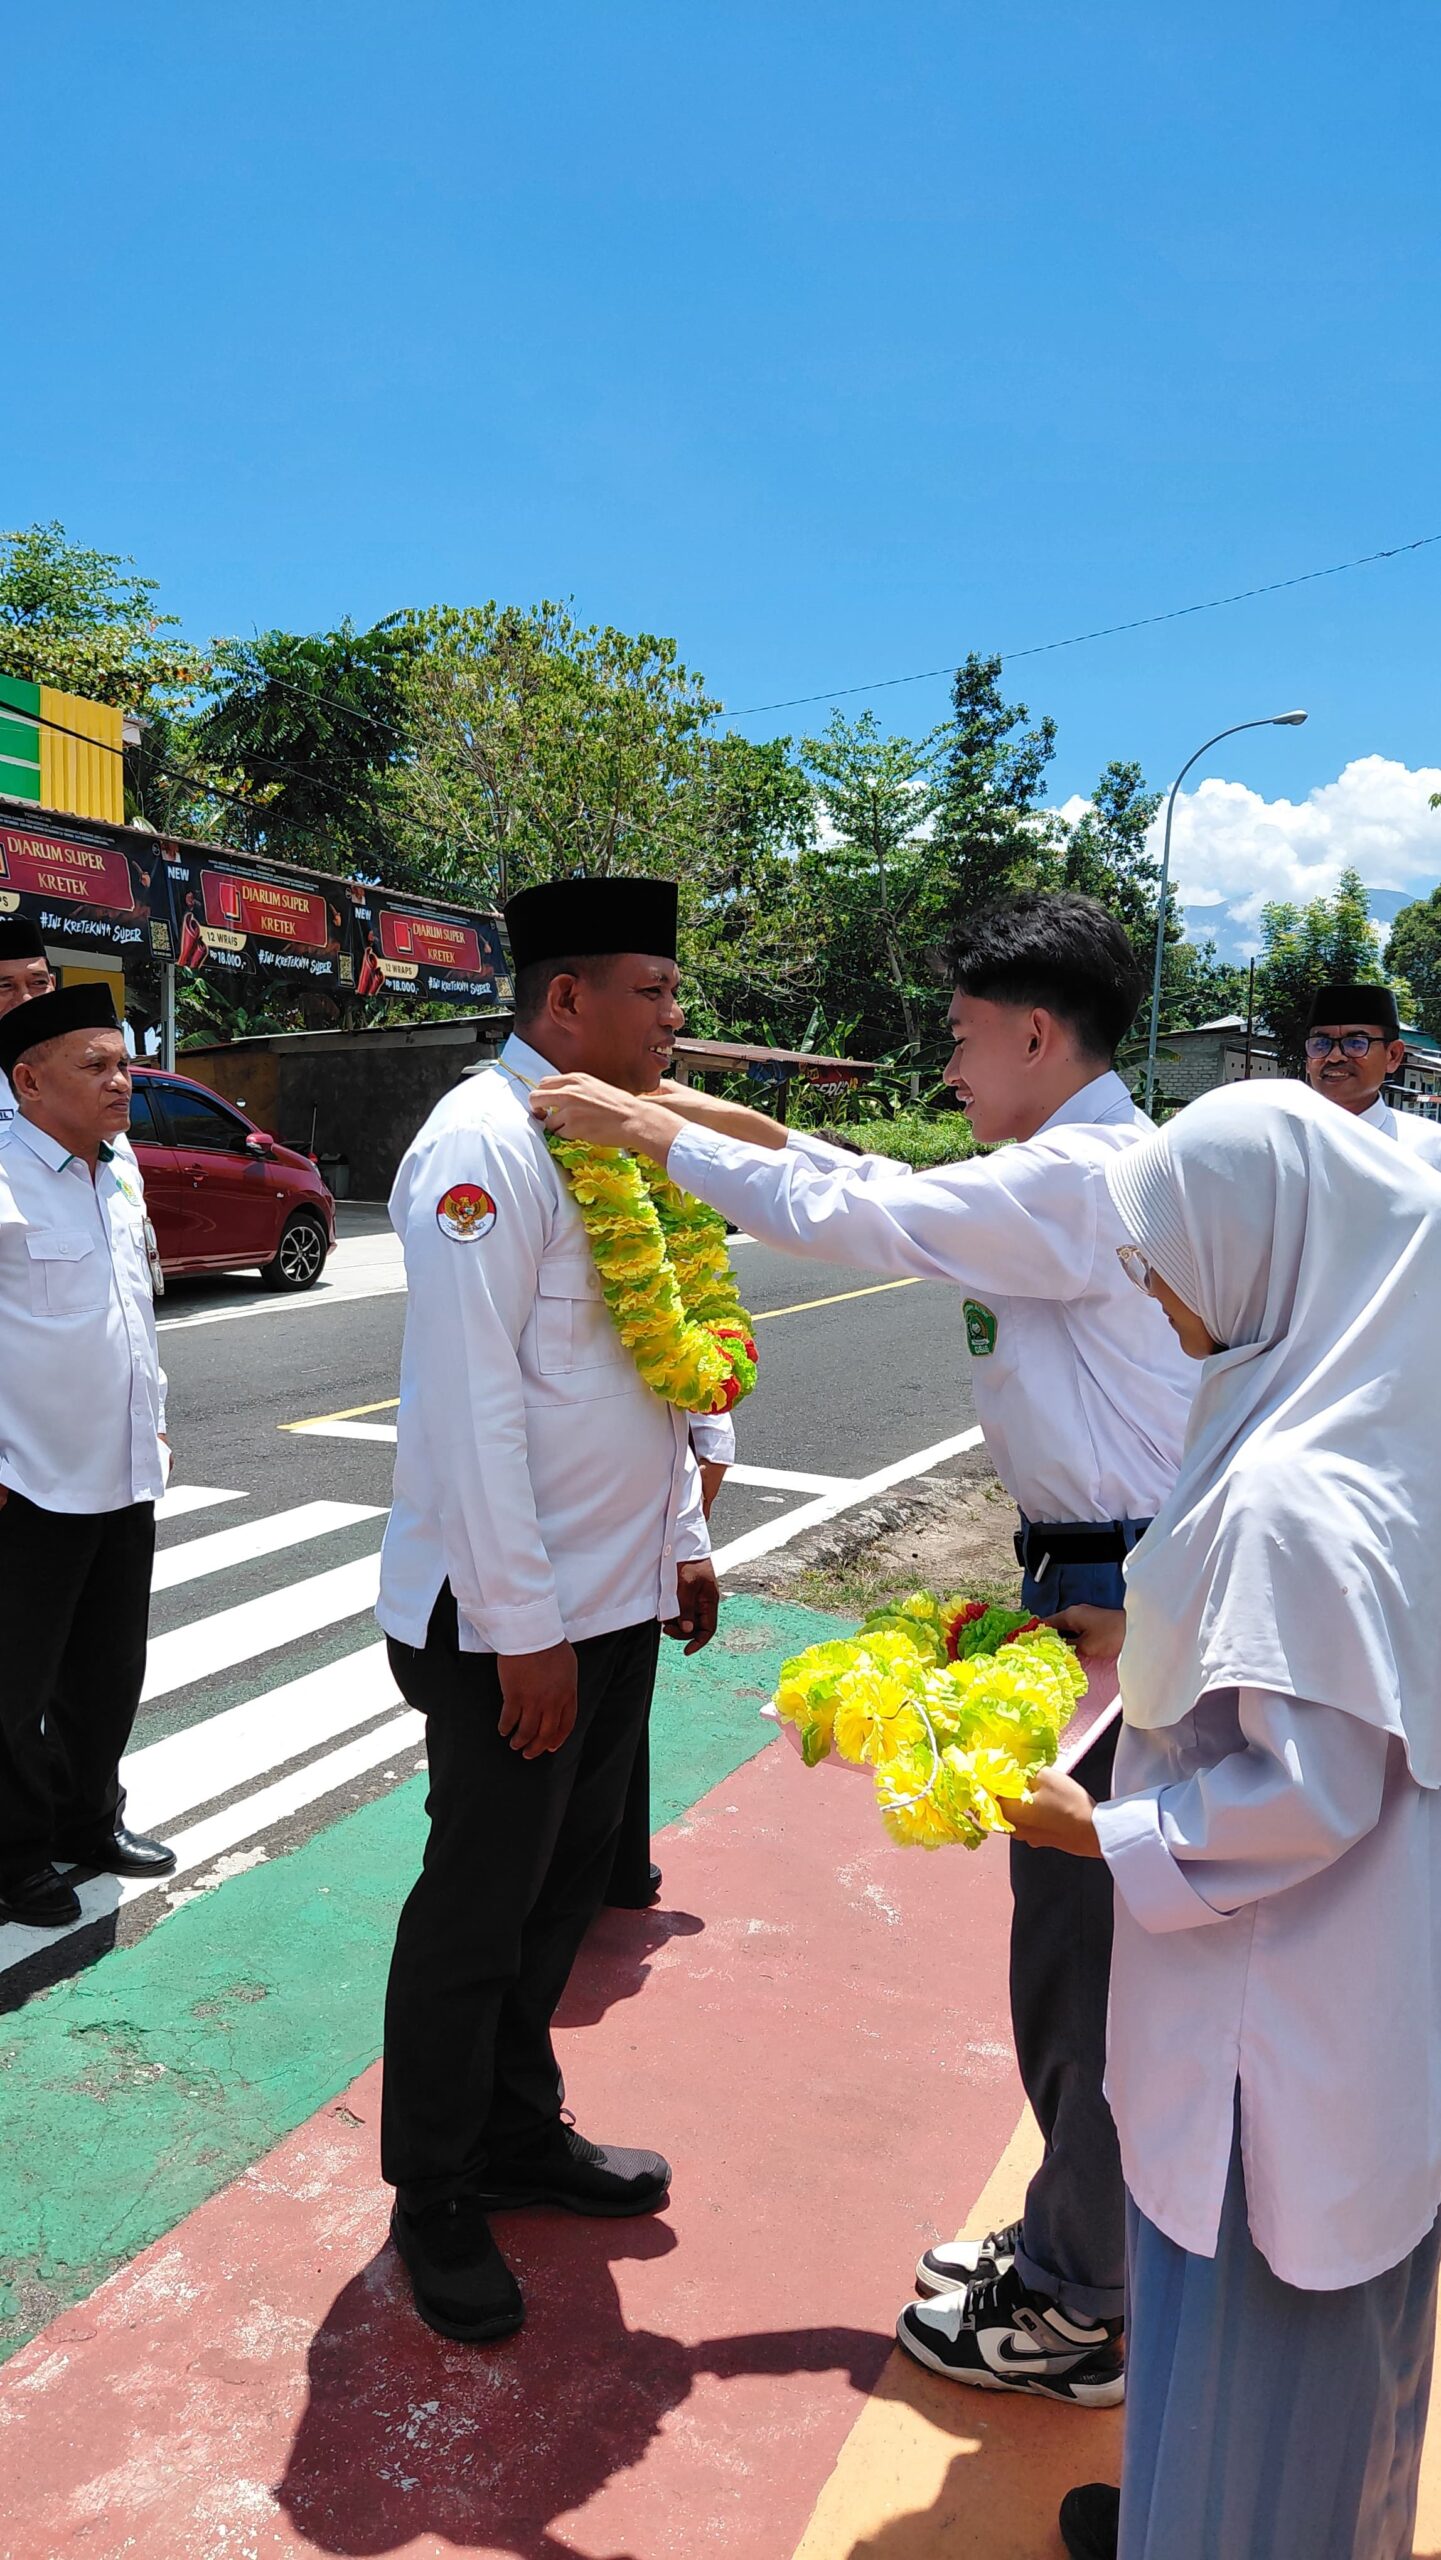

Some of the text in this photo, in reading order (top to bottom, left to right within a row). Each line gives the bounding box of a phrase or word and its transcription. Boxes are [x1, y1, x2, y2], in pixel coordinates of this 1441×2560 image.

[7, 836, 106, 871] DJARUM SUPER
[167, 866, 190, 881] NEW
[37, 872, 90, 897] KRETEK
[242, 885, 310, 913] DJARUM SUPER
[354, 907, 372, 920] NEW
[261, 916, 296, 935] KRETEK
[412, 923, 465, 945] DJARUM SUPER
[112, 925, 144, 944] SUPER
[207, 931, 215, 942] 12
[427, 948, 456, 964] KRETEK
[310, 960, 334, 976] SUPER
[392, 964, 413, 975] WRAPS
